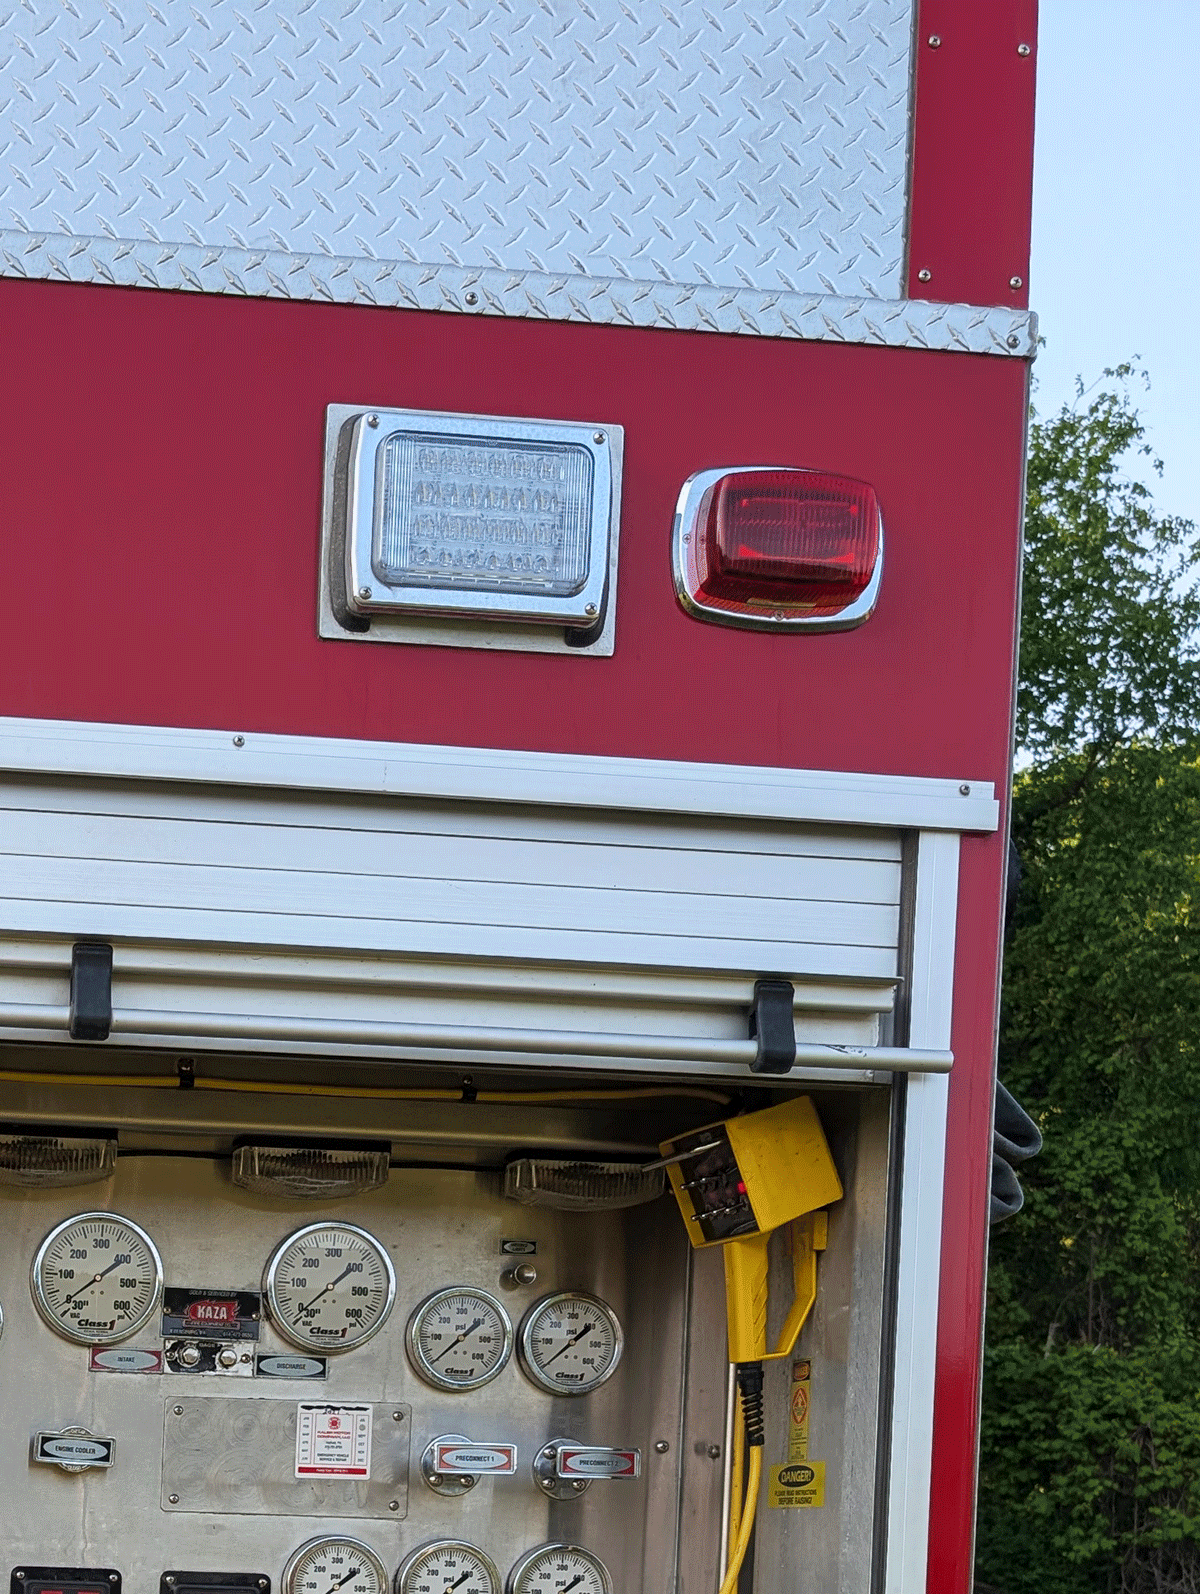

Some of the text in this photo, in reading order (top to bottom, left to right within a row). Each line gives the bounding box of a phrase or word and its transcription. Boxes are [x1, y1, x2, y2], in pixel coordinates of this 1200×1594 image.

[92, 1238, 110, 1249] 300
[70, 1249, 87, 1259] 200
[325, 1248, 342, 1257] 300
[302, 1258, 320, 1268] 200
[58, 1269, 74, 1279] 100
[119, 1278, 137, 1288] 500
[291, 1278, 307, 1287] 100
[351, 1286, 369, 1296] 500
[113, 1300, 131, 1310] 600
[197, 1305, 228, 1320] KAZA
[345, 1308, 362, 1319] 600
[276, 1362, 307, 1371] DISCHARGE
[55, 1445, 74, 1453] ENGINE
[579, 1459, 613, 1467] PRECONNECT
[780, 1469, 812, 1482] DANGER!
[778, 1497, 797, 1505] BEFORE
